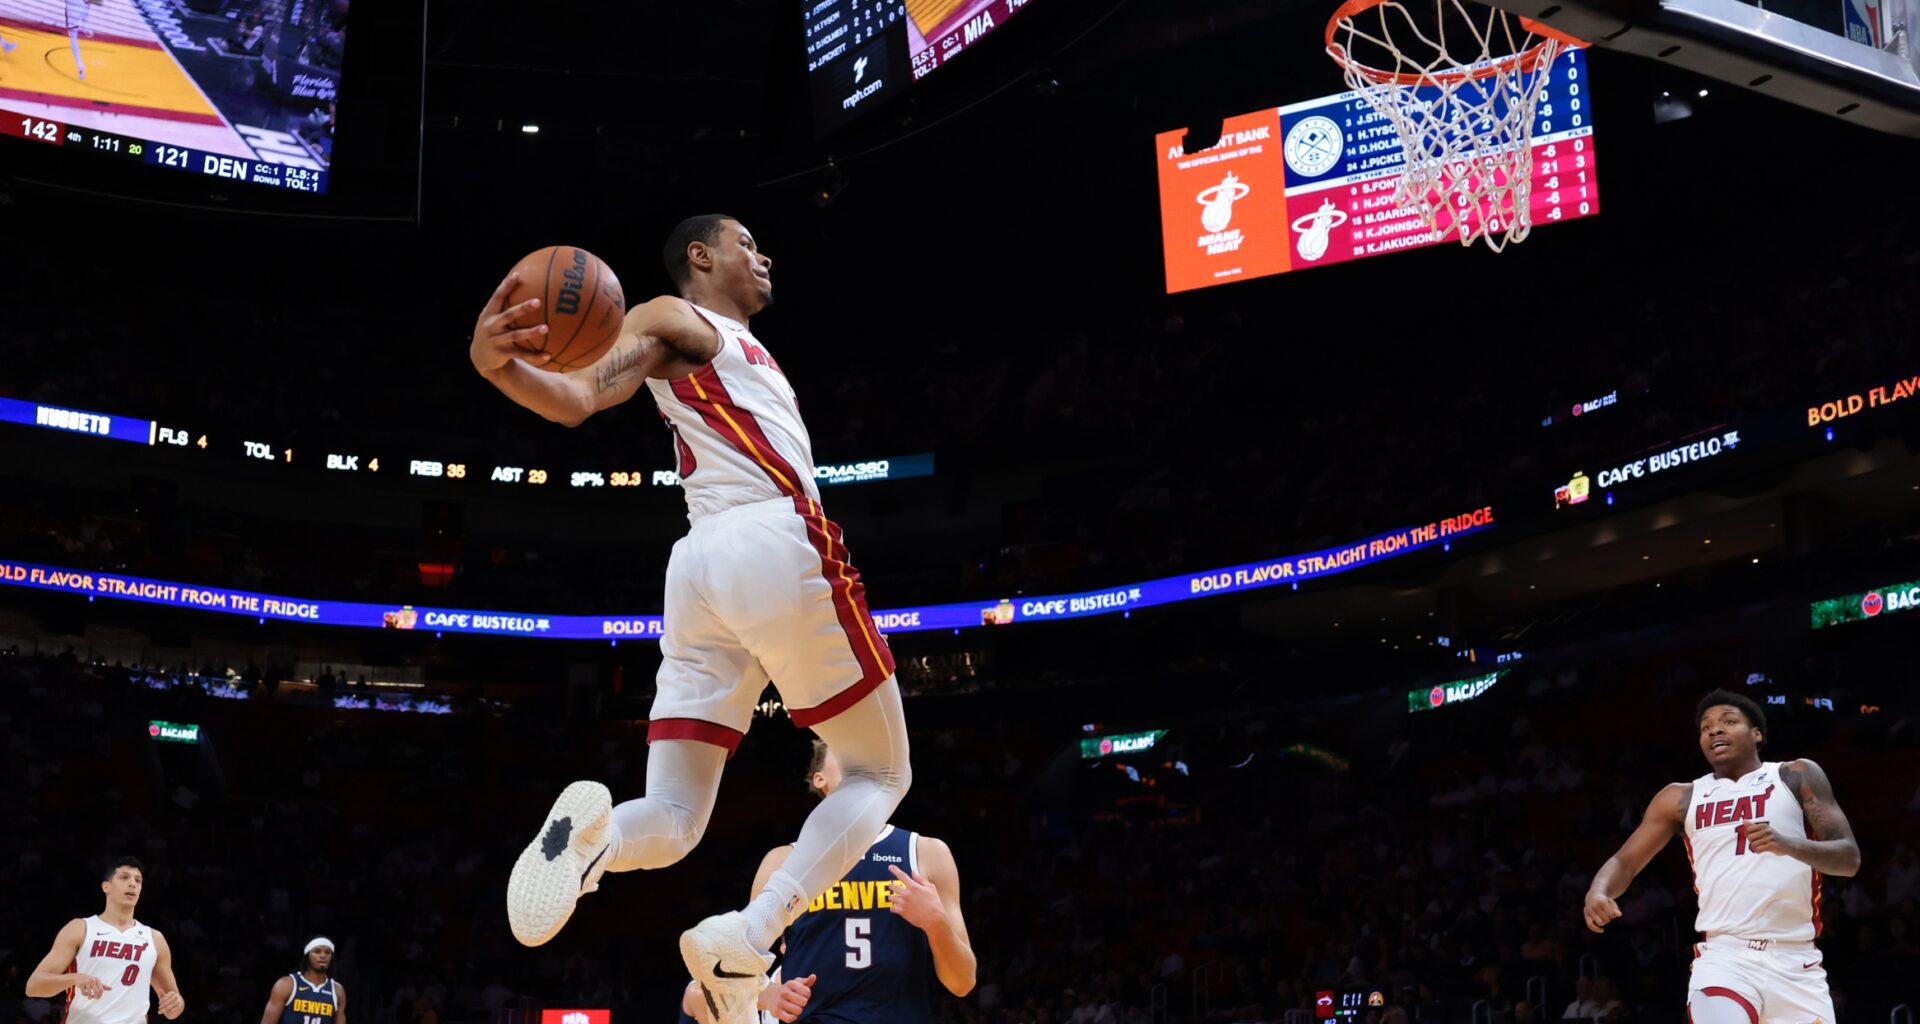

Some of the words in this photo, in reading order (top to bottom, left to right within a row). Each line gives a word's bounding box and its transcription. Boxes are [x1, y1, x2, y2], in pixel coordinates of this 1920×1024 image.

[964, 10, 994, 45] MIA
[1569, 51, 1576, 64] 1
[1568, 67, 1577, 80] 0
[843, 79, 882, 109] mph.com
[1358, 124, 1398, 140] H.TYSO
[1540, 90, 1549, 103] 0
[1570, 83, 1579, 96] 0
[1539, 104, 1553, 117] -8
[1571, 98, 1581, 111] 0
[1542, 120, 1551, 133] 0
[1572, 114, 1582, 127] 0
[1568, 128, 1588, 137] FLS
[1236, 126, 1270, 145] BANK
[22, 118, 58, 142] 142
[67, 131, 82, 142] 4th
[92, 135, 120, 152] 1:11
[129, 144, 142, 155] 20
[155, 146, 188, 168] 121
[204, 155, 247, 180] DEN
[1541, 144, 1556, 158] -6
[1574, 138, 1583, 152] 0
[1541, 160, 1558, 175] 21
[1576, 155, 1585, 168] 3
[253, 174, 280, 186] BONUS
[1544, 176, 1559, 189] -6
[1578, 171, 1586, 183] 1
[1545, 191, 1560, 204] -6
[1580, 186, 1587, 199] 1
[1490, 219, 1499, 231] 0
[1547, 207, 1562, 220] -6
[1580, 202, 1589, 214] 0
[1198, 229, 1240, 247] MIAMI
[555, 249, 588, 315] Wilson
[1808, 394, 1863, 426] BOLD
[1869, 378, 1920, 408] FLAV
[36, 406, 110, 434] NUGGETS
[159, 428, 189, 446] FLS
[197, 435, 208, 449] 4
[244, 441, 275, 460] TOL
[285, 449, 293, 462] 1
[327, 454, 359, 471] BLK
[368, 458, 379, 471] 4
[410, 460, 442, 477] REB
[447, 464, 466, 478] 35
[491, 467, 524, 482] AST
[528, 470, 547, 484] 29
[610, 472, 641, 486] 39.3
[653, 471, 680, 486] FG
[1649, 437, 1722, 473] BUSTELO
[1191, 573, 1232, 593] BOLD
[1236, 563, 1295, 586] FLAVOR
[1298, 545, 1367, 574] STRAIGHT
[1369, 532, 1408, 558] FROM
[1410, 523, 1438, 545] THE
[1440, 506, 1494, 536] FRIDGE
[30, 568, 94, 590] FLAVOR
[97, 577, 178, 602] STRAIGHT
[181, 588, 226, 607] FROM
[230, 595, 259, 611] THE
[263, 599, 319, 619] FRIDGE
[1070, 590, 1127, 612] BUSTELO
[472, 614, 535, 631] BUSTELO
[603, 620, 645, 635] BOLD
[872, 612, 920, 628] RIDGE
[1695, 783, 1776, 831] HEAT
[872, 852, 902, 863] ibotta
[90, 940, 148, 962] HEAT
[845, 917, 872, 969] 5
[121, 963, 140, 987] 0
[293, 998, 334, 1017] DENVER
